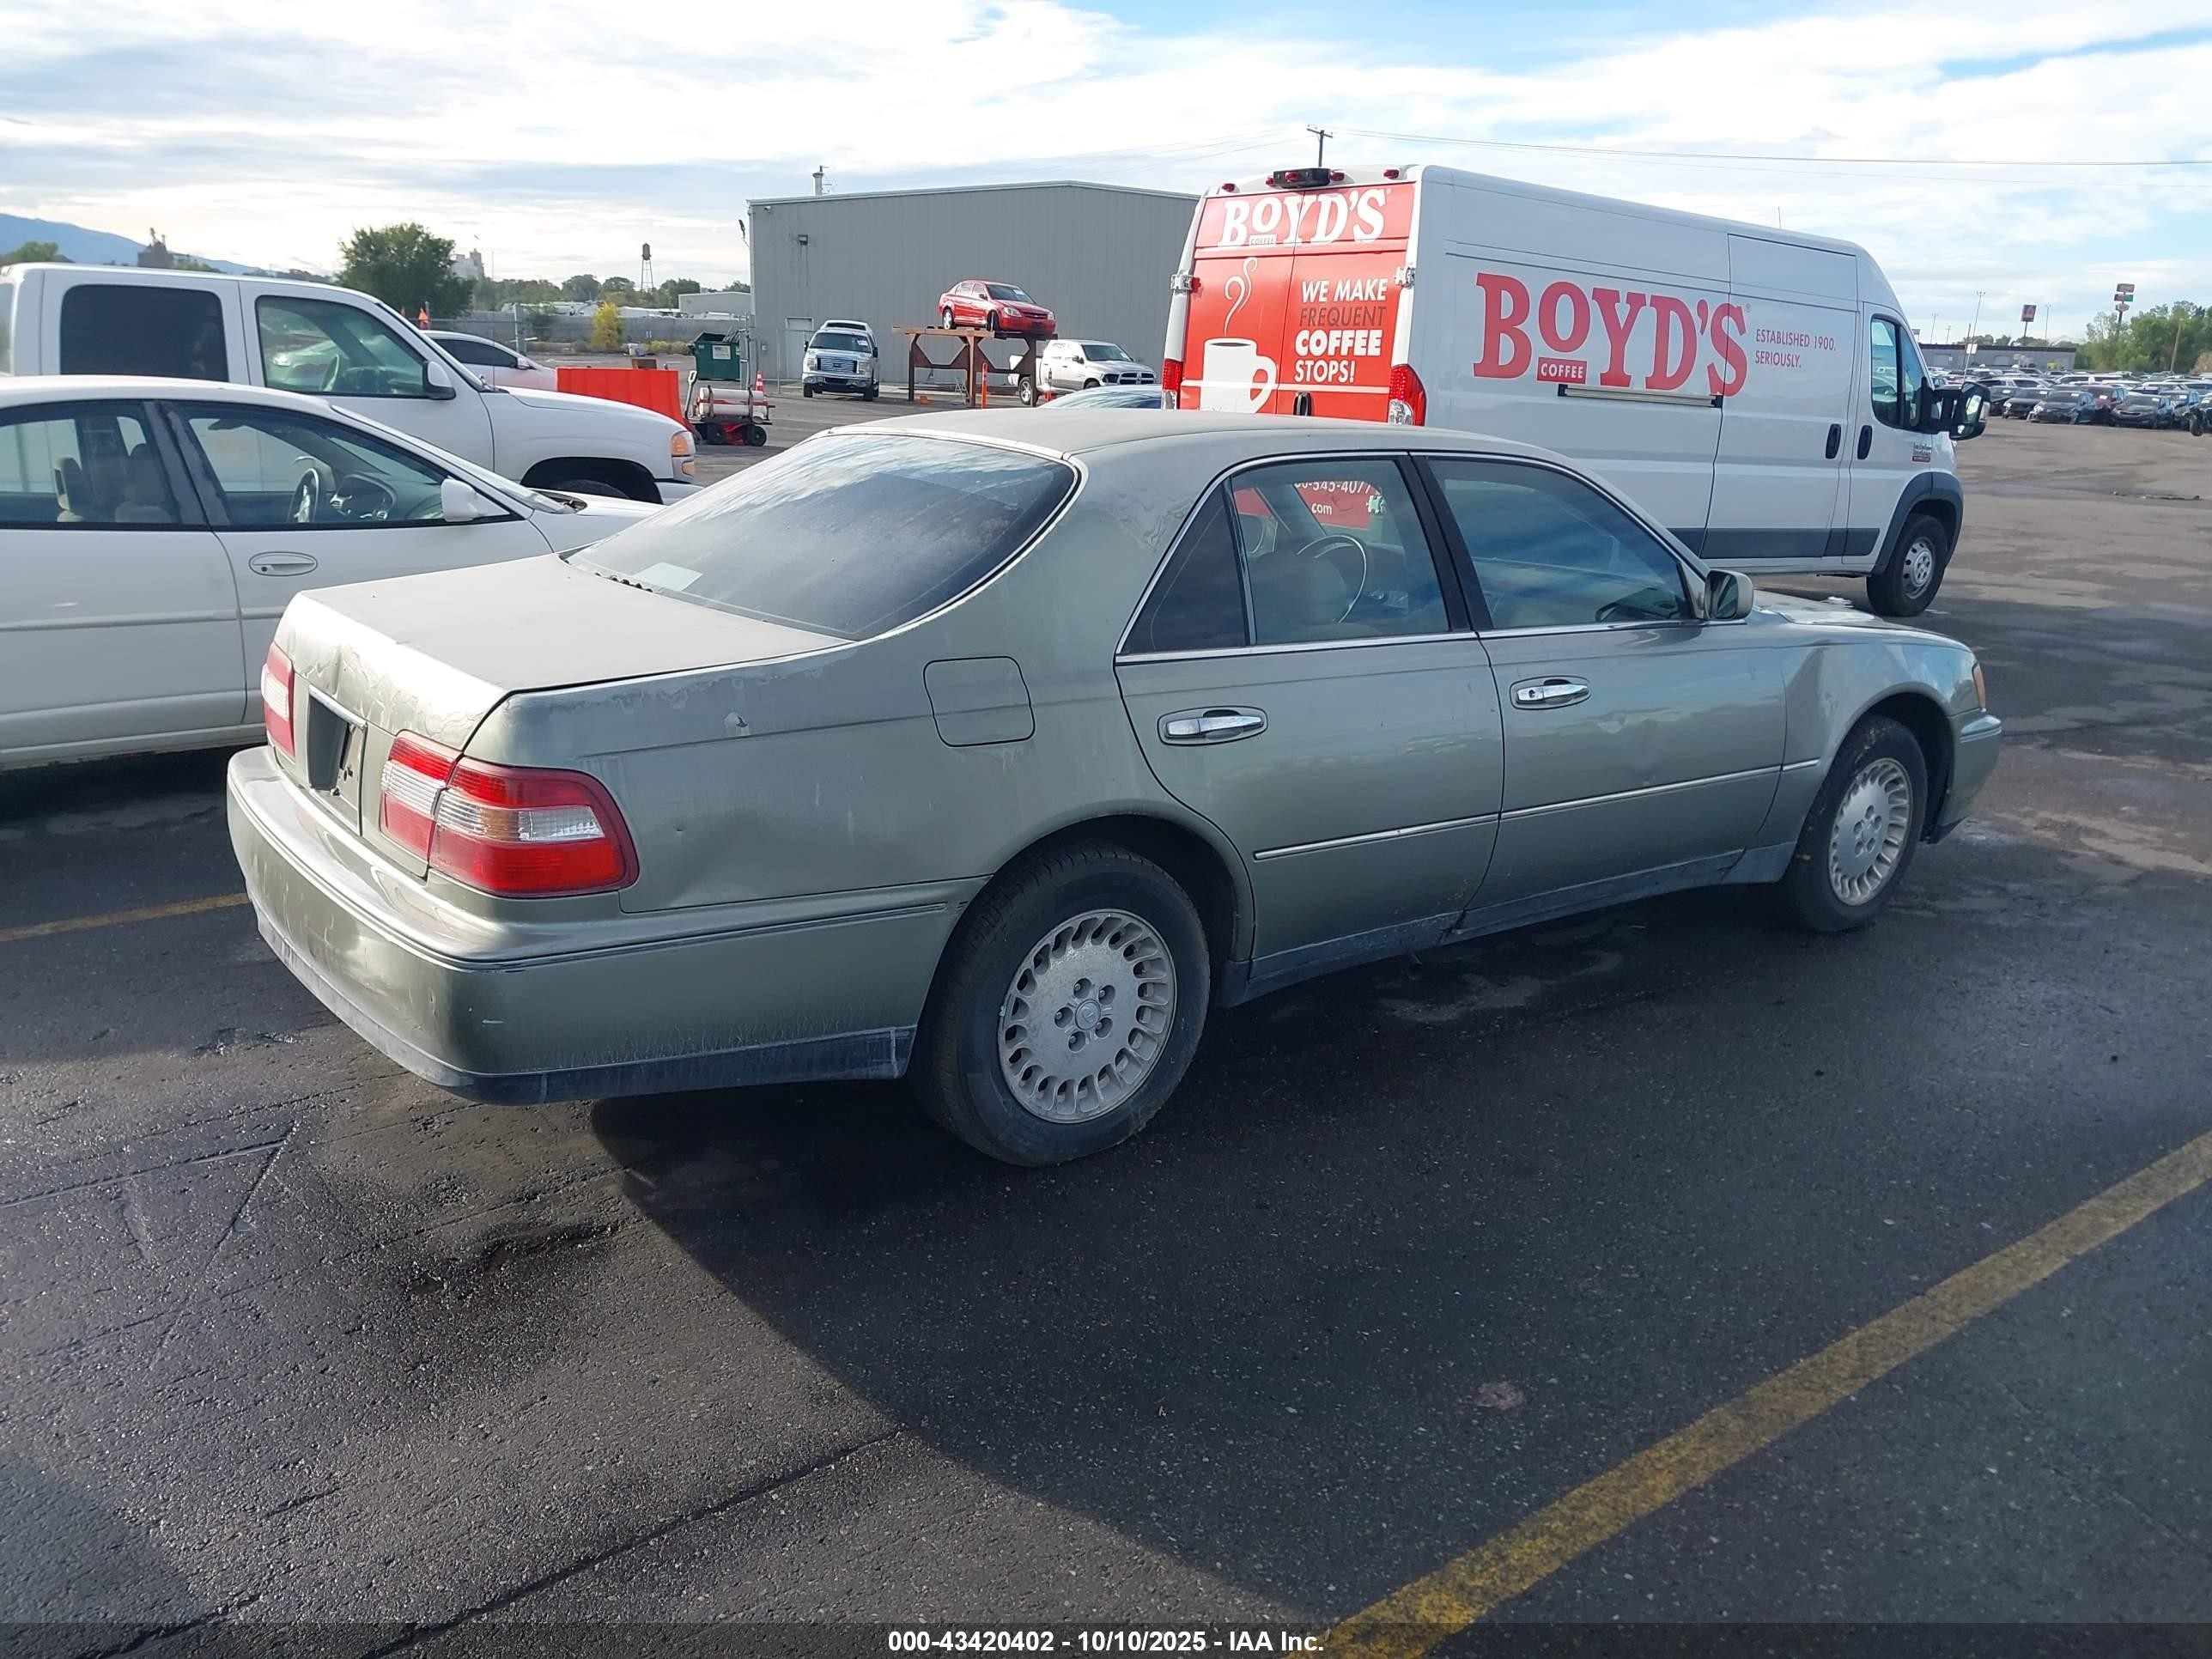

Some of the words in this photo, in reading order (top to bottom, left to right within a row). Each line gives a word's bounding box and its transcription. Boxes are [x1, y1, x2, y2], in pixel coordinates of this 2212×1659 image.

[1218, 187, 1387, 247] BOYD'S
[1302, 279, 1329, 303] WE
[1333, 277, 1389, 302] MAKE
[1298, 306, 1387, 327] FREQUENT
[1294, 329, 1383, 356] COFFEE
[1473, 271, 1748, 397] BOYD'S
[1755, 328, 1810, 348] ESTABLISHED
[1814, 336, 1836, 351] 1900.
[1754, 349, 1802, 368] SERIOUSLY.
[1294, 359, 1356, 383] STOPS!
[1540, 362, 1584, 380] COFFEE
